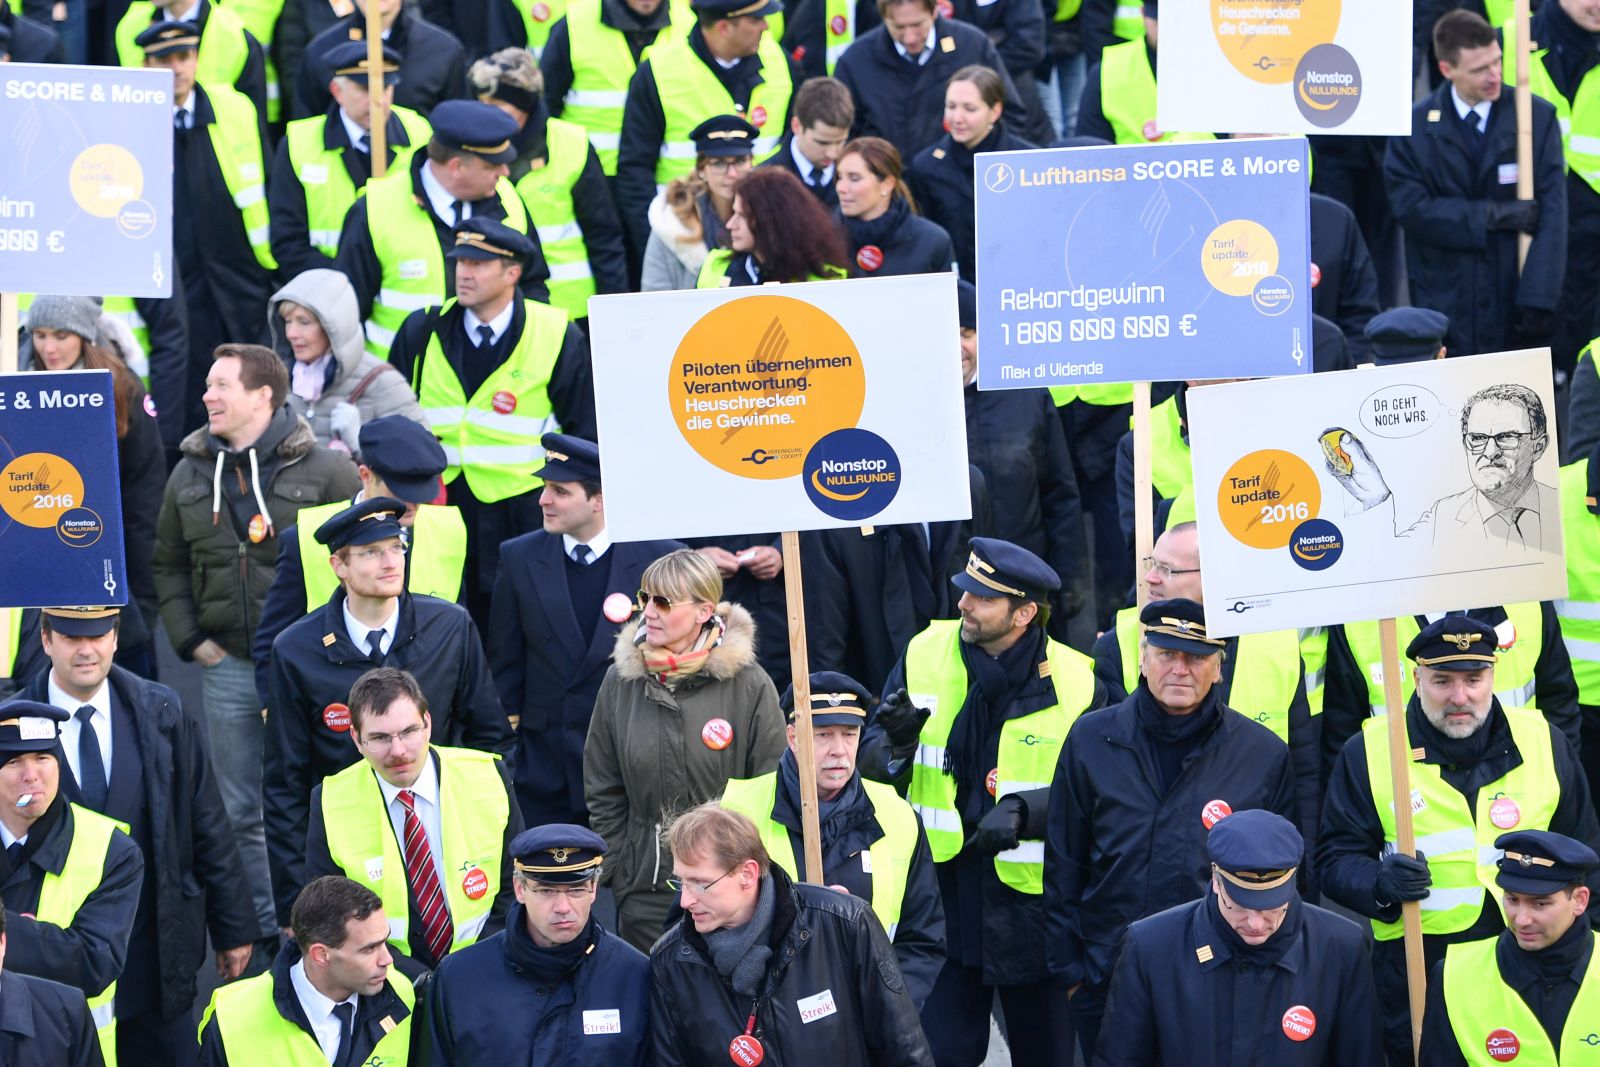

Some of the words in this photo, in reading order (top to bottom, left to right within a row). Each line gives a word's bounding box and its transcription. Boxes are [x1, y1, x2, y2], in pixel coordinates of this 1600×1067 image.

[1219, 23, 1236, 35] die
[1306, 70, 1353, 86] Nonstop
[6, 80, 85, 100] SCORE
[90, 84, 105, 102] &
[111, 85, 167, 104] More
[1309, 86, 1359, 96] NULLRUNDE
[1019, 166, 1127, 188] Lufthansa
[1132, 158, 1214, 181] SCORE
[1220, 157, 1237, 176] &
[1243, 155, 1301, 175] More
[46, 230, 65, 252] €
[1212, 239, 1235, 249] Tarif
[1212, 250, 1249, 261] update
[1233, 262, 1269, 276] 2016
[1001, 281, 1165, 311] Rekordgewinn
[1001, 323, 1010, 345] 1
[1017, 320, 1062, 345] 800
[1070, 317, 1116, 342] 000
[1123, 315, 1170, 339] 000
[1178, 313, 1198, 337] €
[683, 362, 741, 377] Piloten
[746, 356, 852, 373] übernehmen
[1001, 365, 1031, 380] Max
[1034, 362, 1046, 378] di
[1049, 361, 1104, 378] Vidende
[684, 376, 812, 394] Verantwortung.
[13, 391, 32, 410] &
[39, 390, 104, 408] More
[686, 394, 806, 412] Heuschrecken
[1374, 398, 1389, 412] DA
[1392, 396, 1418, 410] GEHT
[686, 416, 713, 430] die
[717, 412, 795, 429] Gewinne.
[1375, 413, 1400, 427] NOCH
[1404, 411, 1429, 423] WAS.
[767, 447, 803, 455] VEREINIGUNG
[822, 459, 887, 474] Nonstop
[8, 471, 34, 481] Tarif
[826, 472, 897, 486] NULLRUNDE
[1230, 475, 1261, 490] Tarif
[9, 481, 50, 493] update
[33, 494, 73, 509] 2016
[1231, 488, 1281, 506] update
[1261, 501, 1309, 525] 2016
[65, 519, 96, 528] Nonstop
[1299, 534, 1336, 547] Nonstop
[1302, 541, 1341, 552] NULLRUNDE
[801, 1000, 834, 1020] Streik!
[584, 1021, 619, 1033] Streik!
[731, 1042, 754, 1066] STREIK!
[1488, 1046, 1517, 1056] STREIK!
